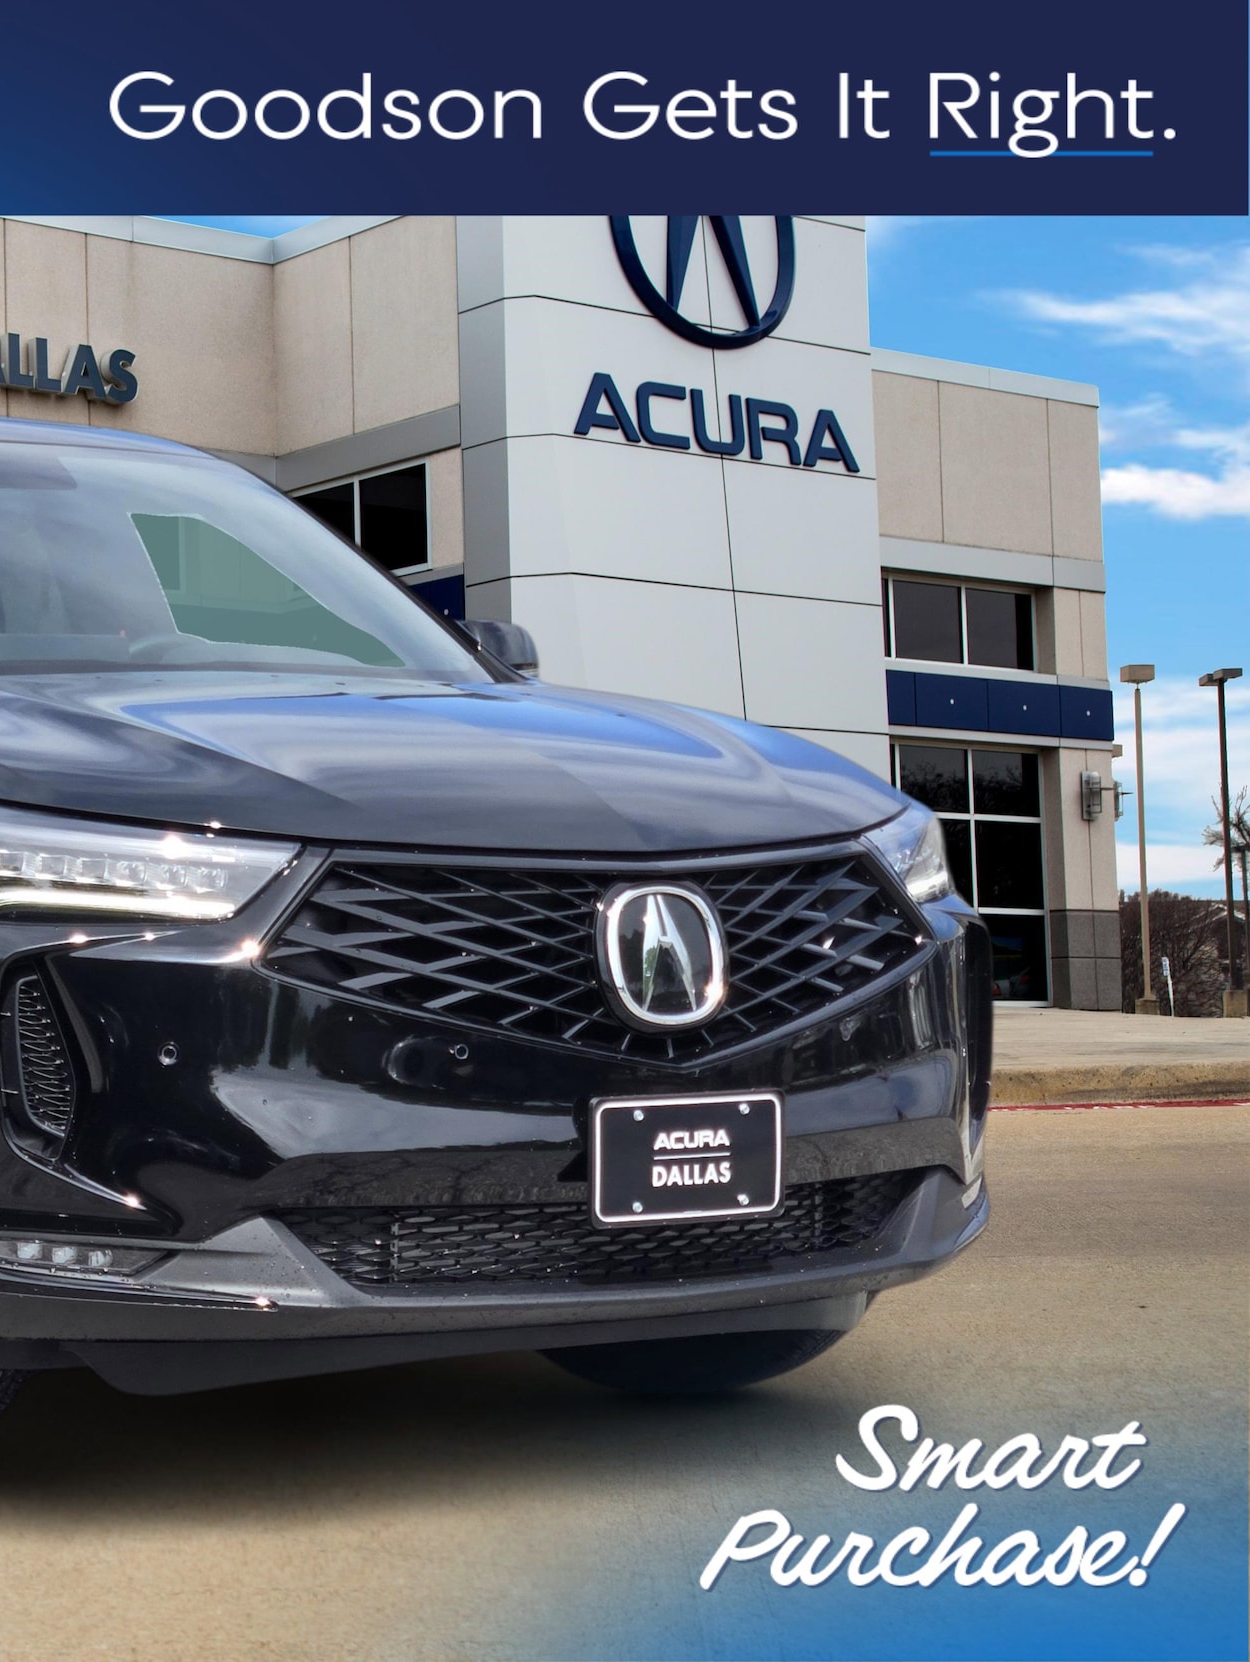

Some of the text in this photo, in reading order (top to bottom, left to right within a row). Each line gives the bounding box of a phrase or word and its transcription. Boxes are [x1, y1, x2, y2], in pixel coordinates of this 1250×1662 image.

[573, 372, 860, 472] ACURA
[653, 1129, 730, 1151] ACURA
[652, 1161, 732, 1188] DALLAS
